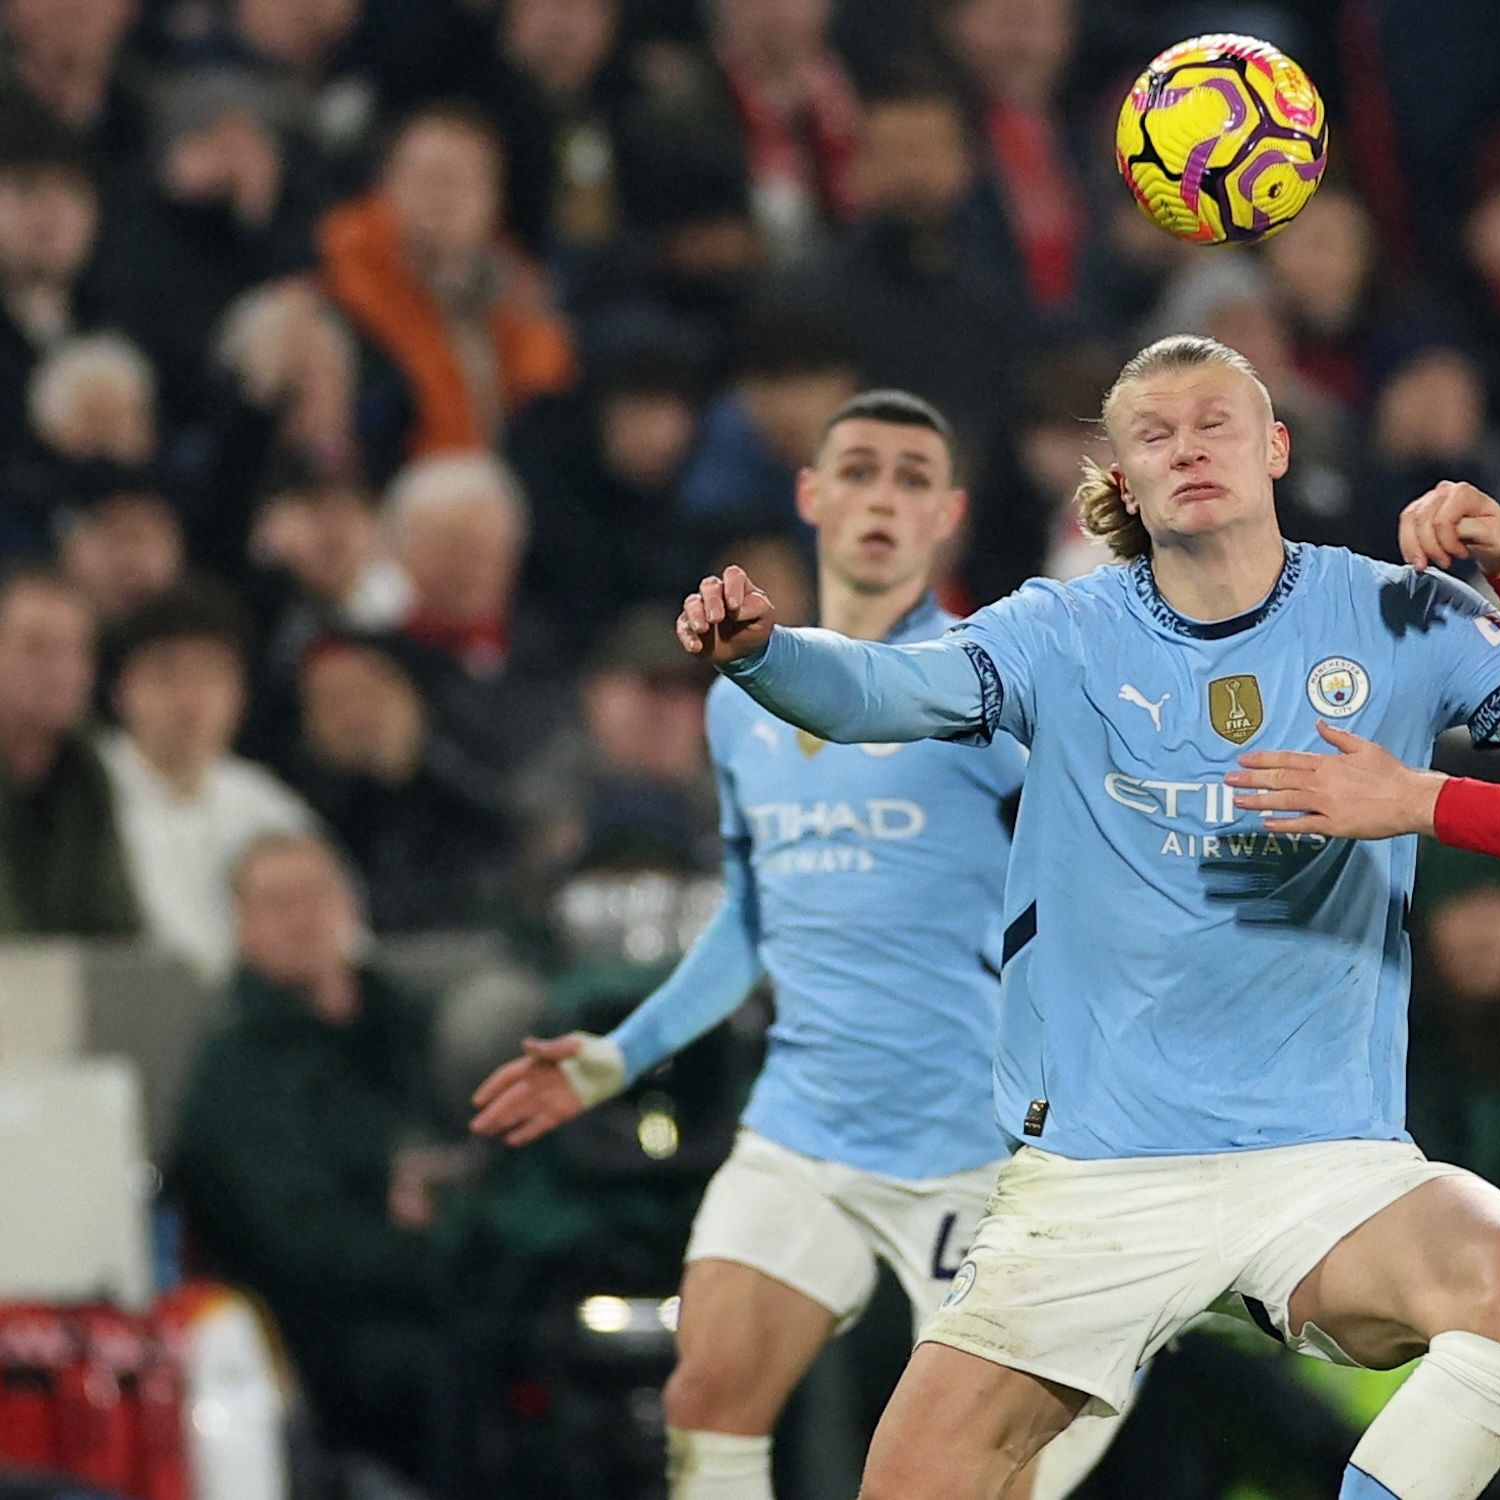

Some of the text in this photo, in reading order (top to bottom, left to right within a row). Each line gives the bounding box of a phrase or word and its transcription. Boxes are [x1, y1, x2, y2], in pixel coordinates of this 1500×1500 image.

[1311, 661, 1360, 684] MANCHESTER
[1334, 707, 1352, 715] CITY
[1226, 718, 1251, 730] FIFA
[744, 797, 926, 842] TIHAD
